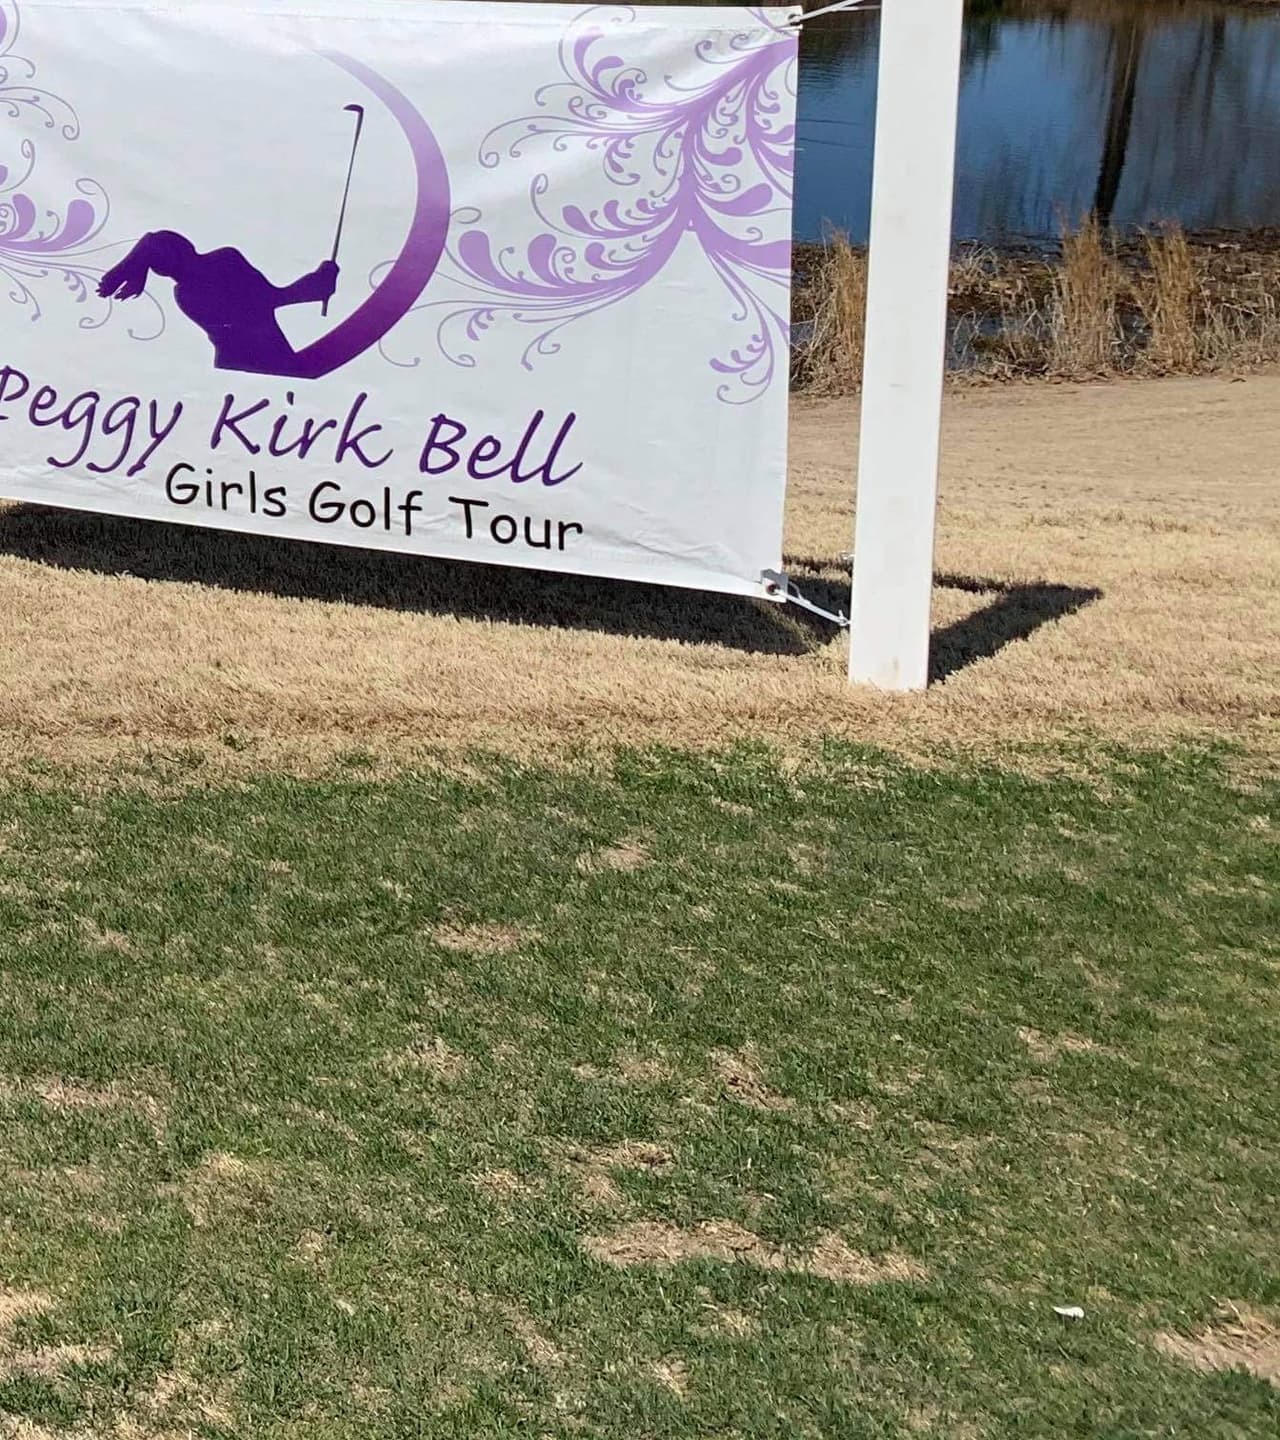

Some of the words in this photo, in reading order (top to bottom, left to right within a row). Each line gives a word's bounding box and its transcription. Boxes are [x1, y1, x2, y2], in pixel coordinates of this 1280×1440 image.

[210, 391, 394, 469] Kirk
[419, 409, 584, 487] Bell
[165, 463, 288, 519] Girls
[309, 482, 425, 537] Golf
[449, 496, 584, 553] Tour
